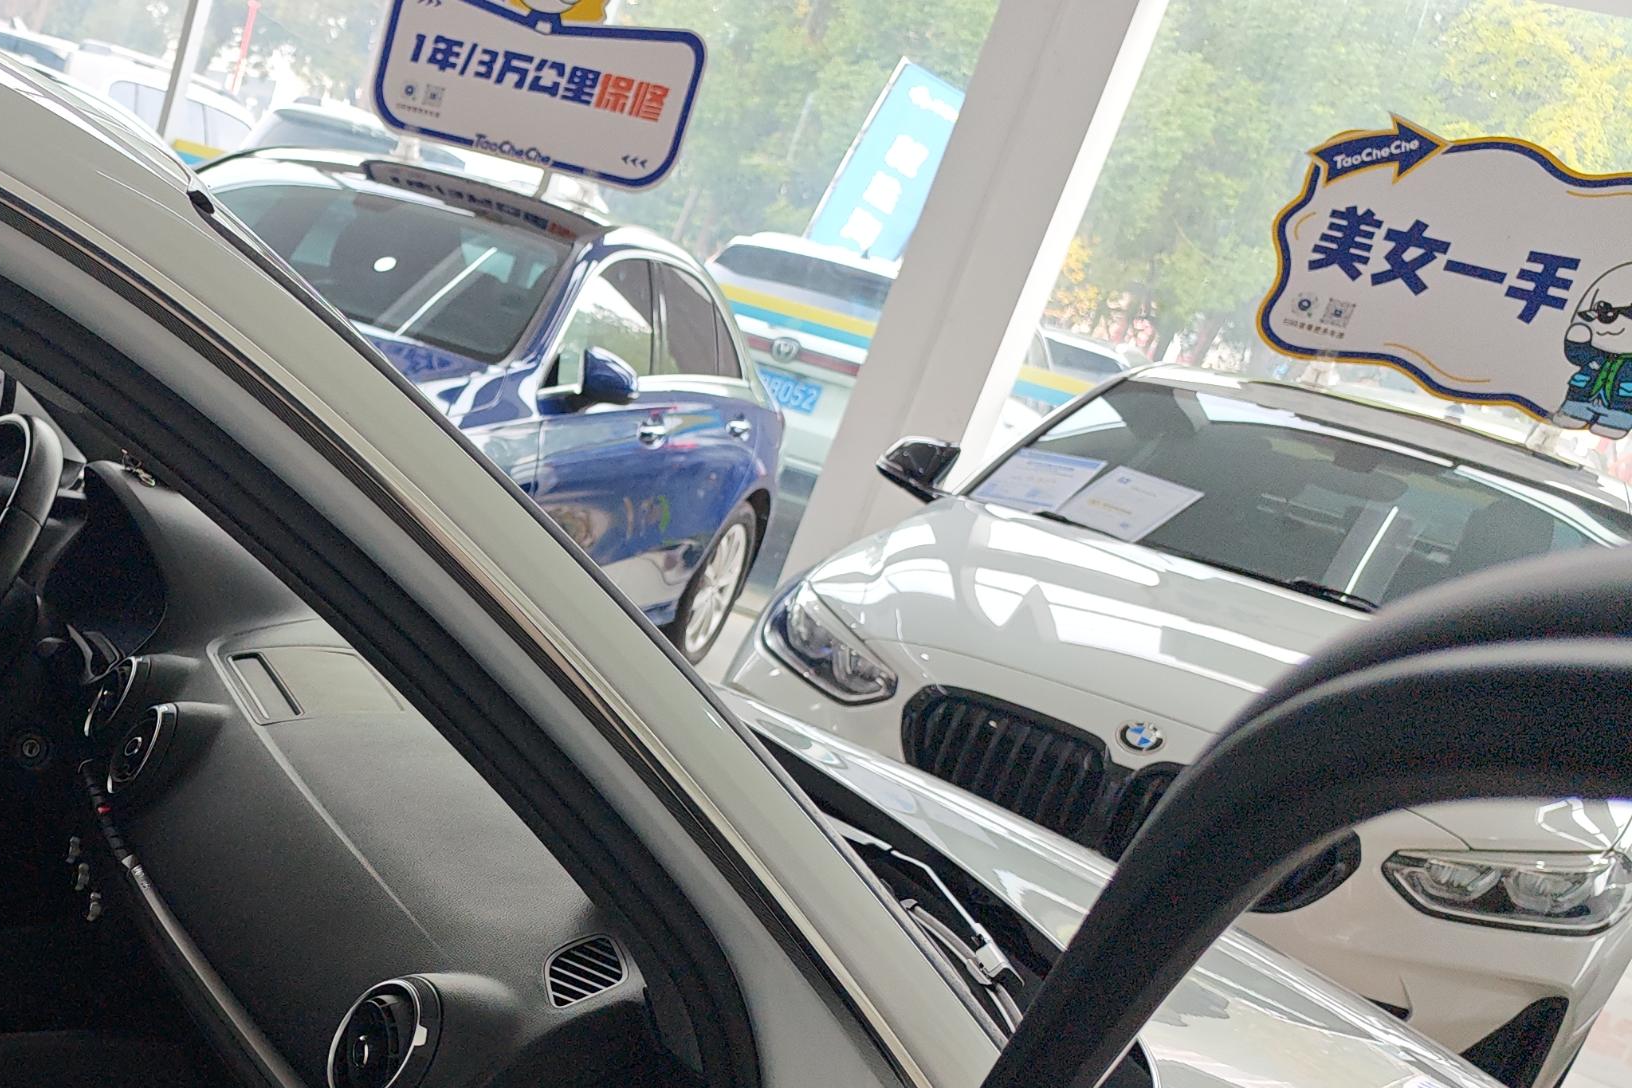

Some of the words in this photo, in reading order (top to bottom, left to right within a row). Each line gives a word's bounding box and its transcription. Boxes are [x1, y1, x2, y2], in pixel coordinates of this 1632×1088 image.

[409, 33, 670, 123] 1年/3万公里保修
[472, 133, 553, 165] TaoCheChe
[1333, 138, 1420, 170] TaoCheChe
[1308, 205, 1581, 325] 美女一手
